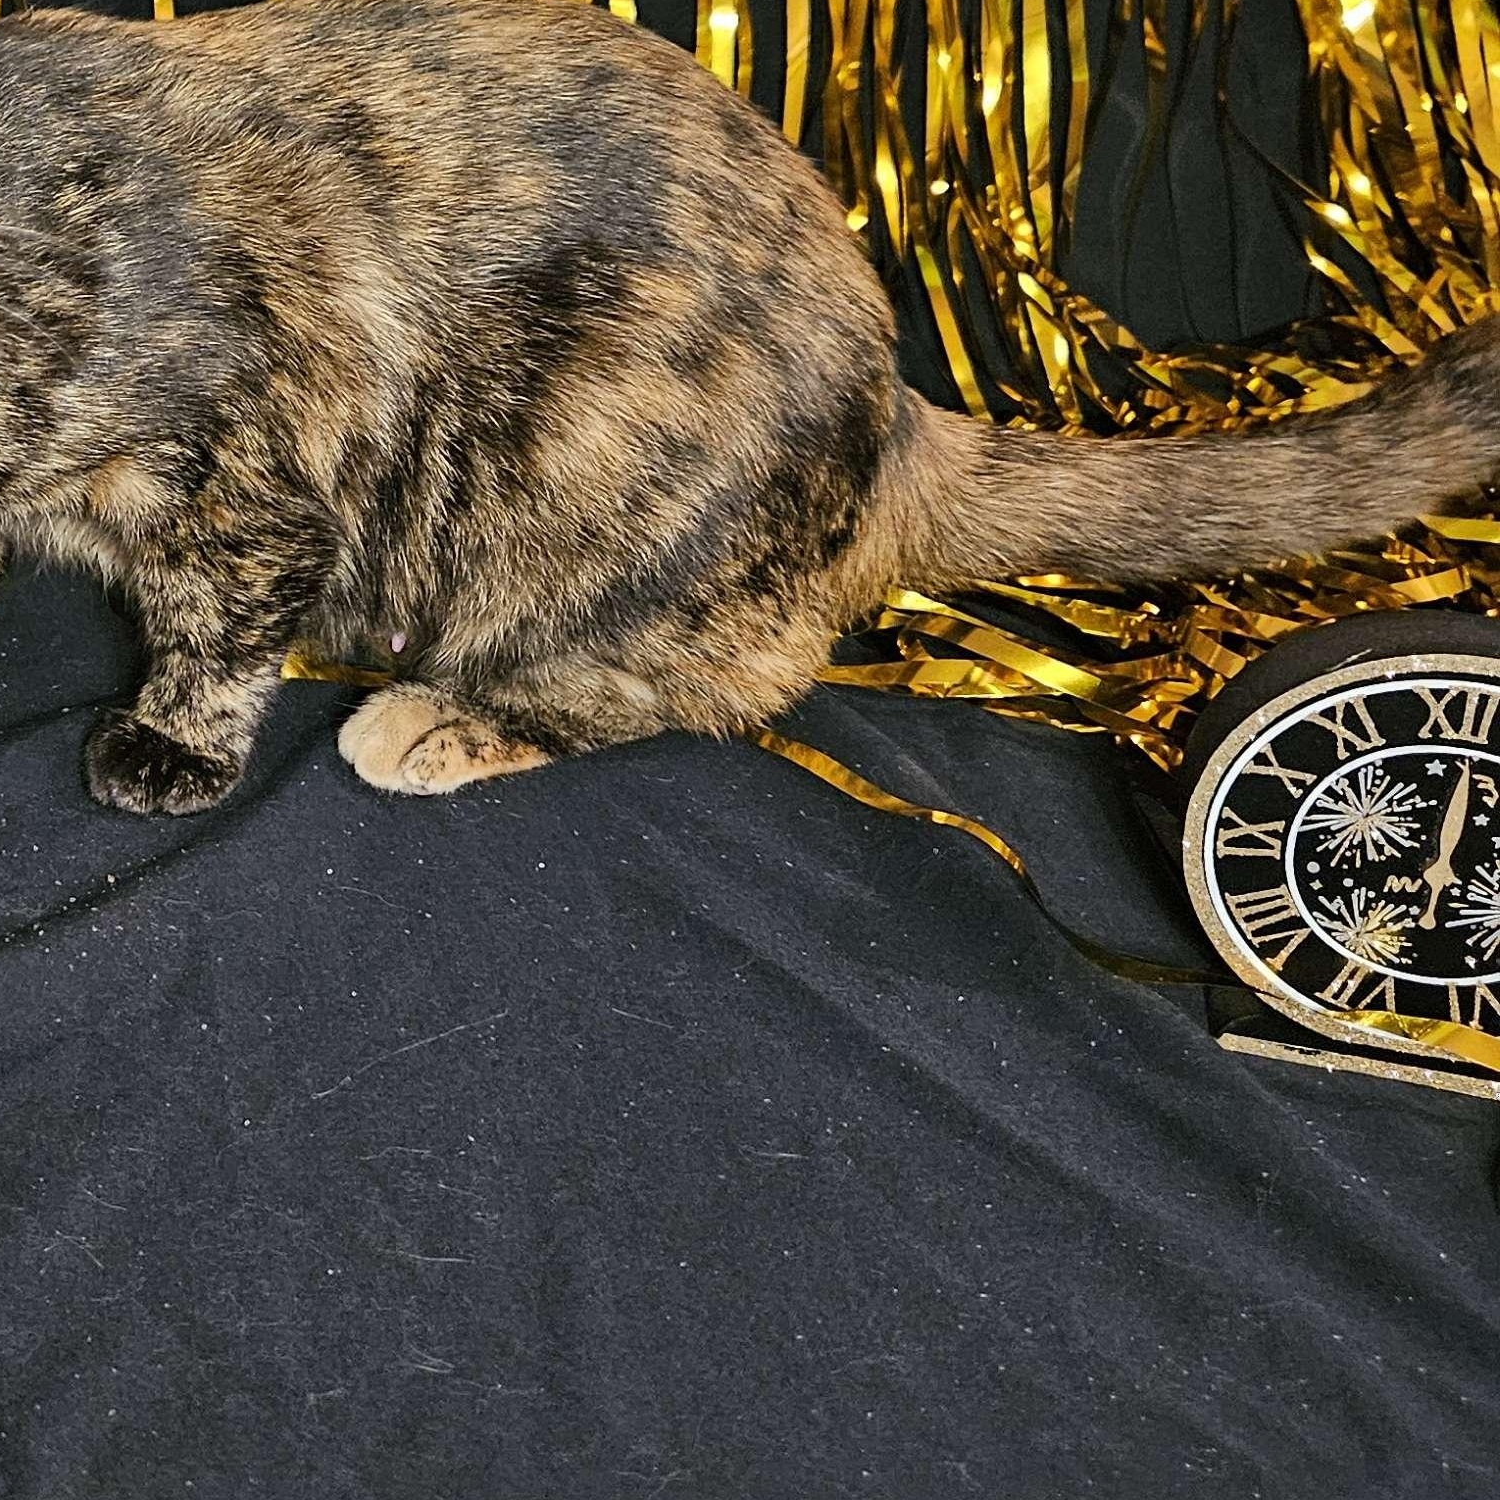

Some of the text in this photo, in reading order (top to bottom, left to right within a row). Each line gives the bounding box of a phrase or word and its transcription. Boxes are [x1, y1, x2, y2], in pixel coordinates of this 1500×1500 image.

[1304, 694, 1386, 760] XI
[1412, 685, 1500, 745] XII
[1241, 742, 1317, 799] X
[1217, 806, 1286, 860] IX
[1225, 884, 1312, 971] VIII
